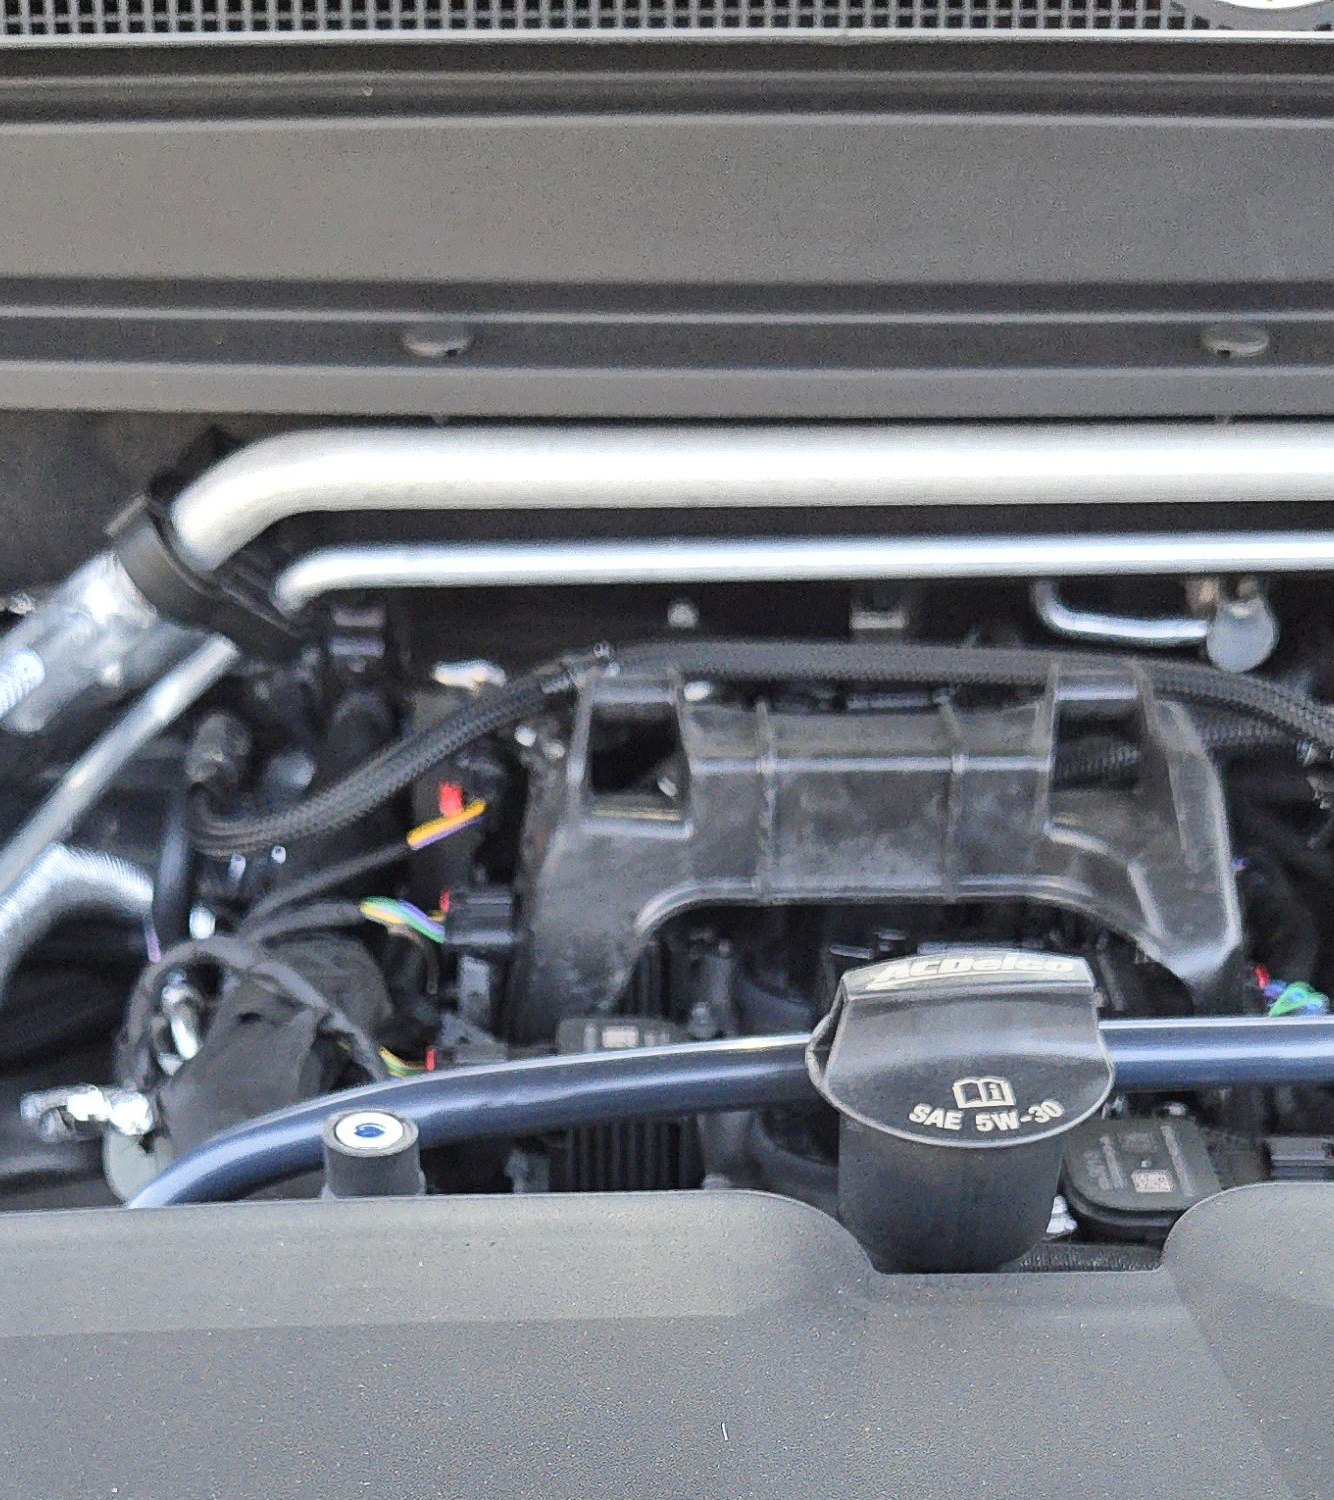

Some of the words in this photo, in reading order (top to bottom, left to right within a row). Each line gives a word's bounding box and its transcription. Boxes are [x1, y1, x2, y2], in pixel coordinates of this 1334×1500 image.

[874, 952, 1074, 984] ACDelco
[909, 1103, 963, 1131] SAE
[975, 1100, 1065, 1133] 5W-30
